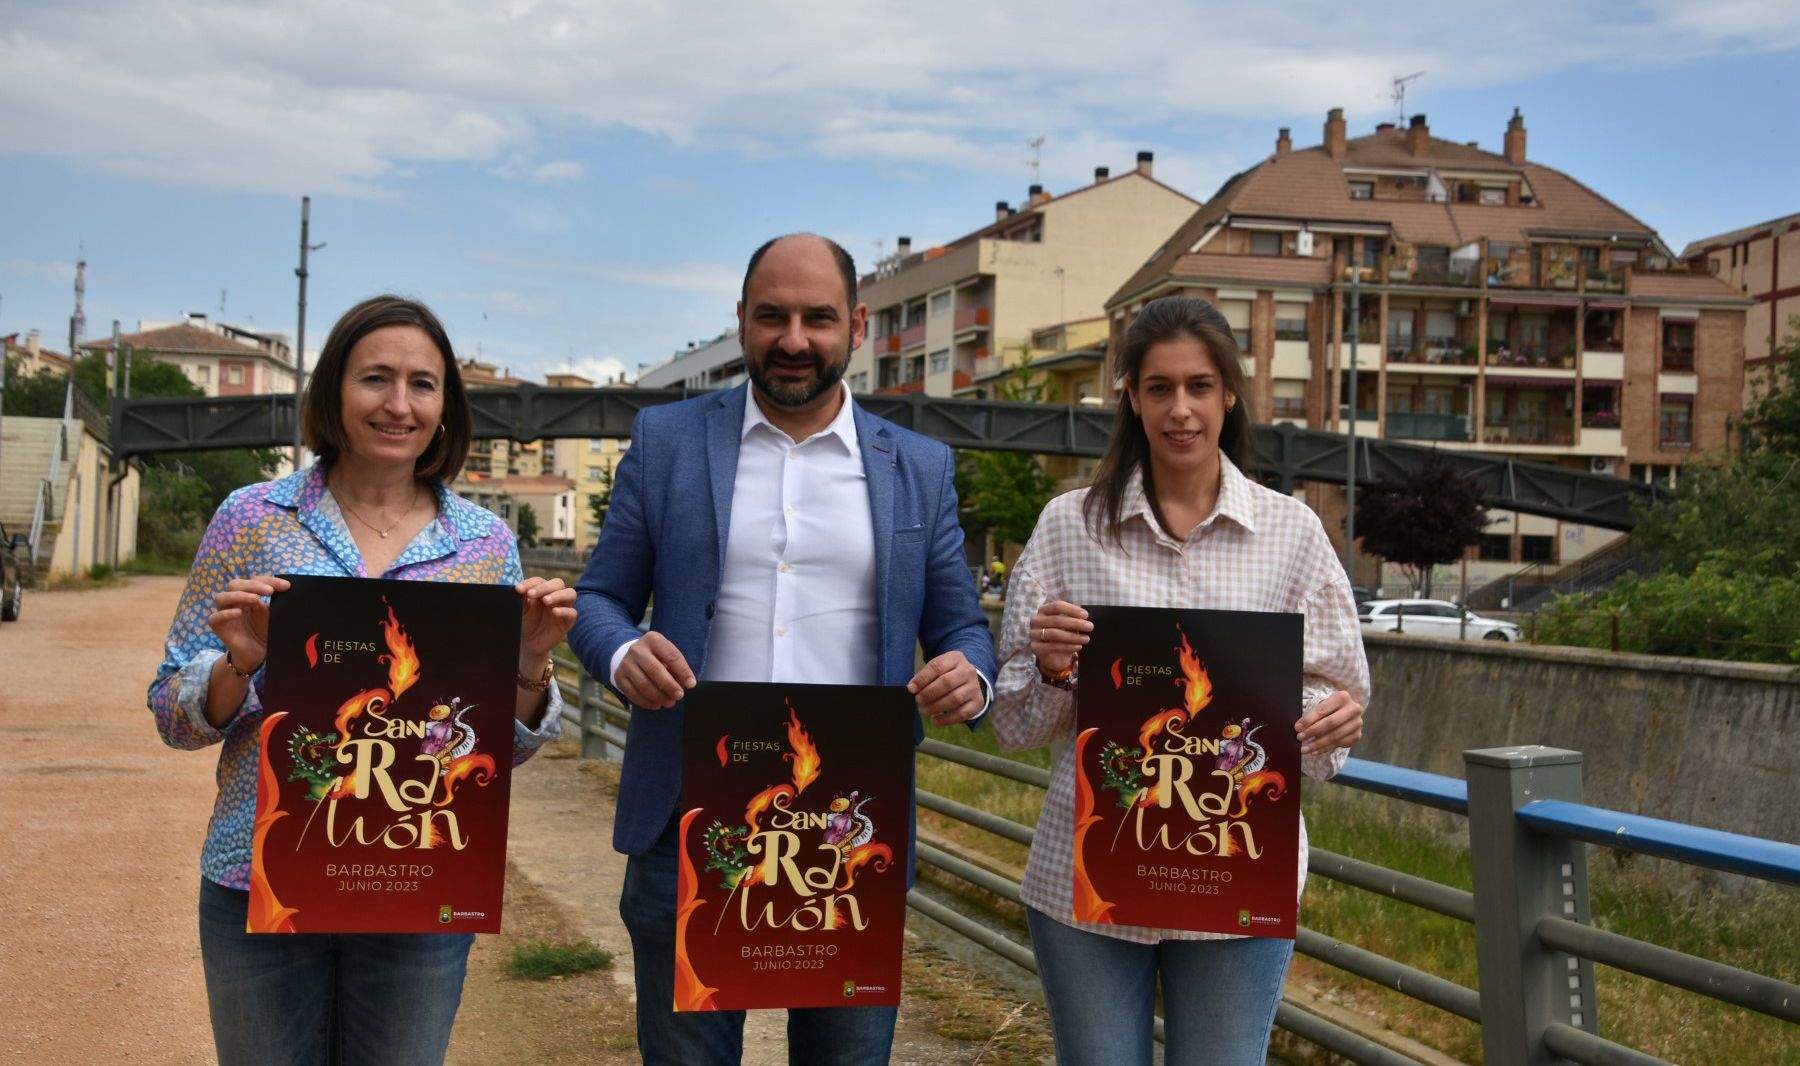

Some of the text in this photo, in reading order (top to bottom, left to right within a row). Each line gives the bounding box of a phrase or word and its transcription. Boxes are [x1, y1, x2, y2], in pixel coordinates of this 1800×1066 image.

[324, 640, 376, 651] FIESTAS
[323, 653, 341, 663] DE
[1127, 665, 1172, 675] FIESTAS
[1126, 676, 1142, 686] DE
[733, 741, 780, 751] FIESTAS
[733, 753, 749, 762] DE
[326, 864, 434, 877] BARBASTRO
[1137, 865, 1232, 883] BARBASTRO
[338, 881, 418, 892] JUNIO 2023
[1149, 881, 1219, 895] JUNIO 2023
[741, 944, 838, 958] BARBASTRO
[752, 959, 824, 971] JUNIO 2023
